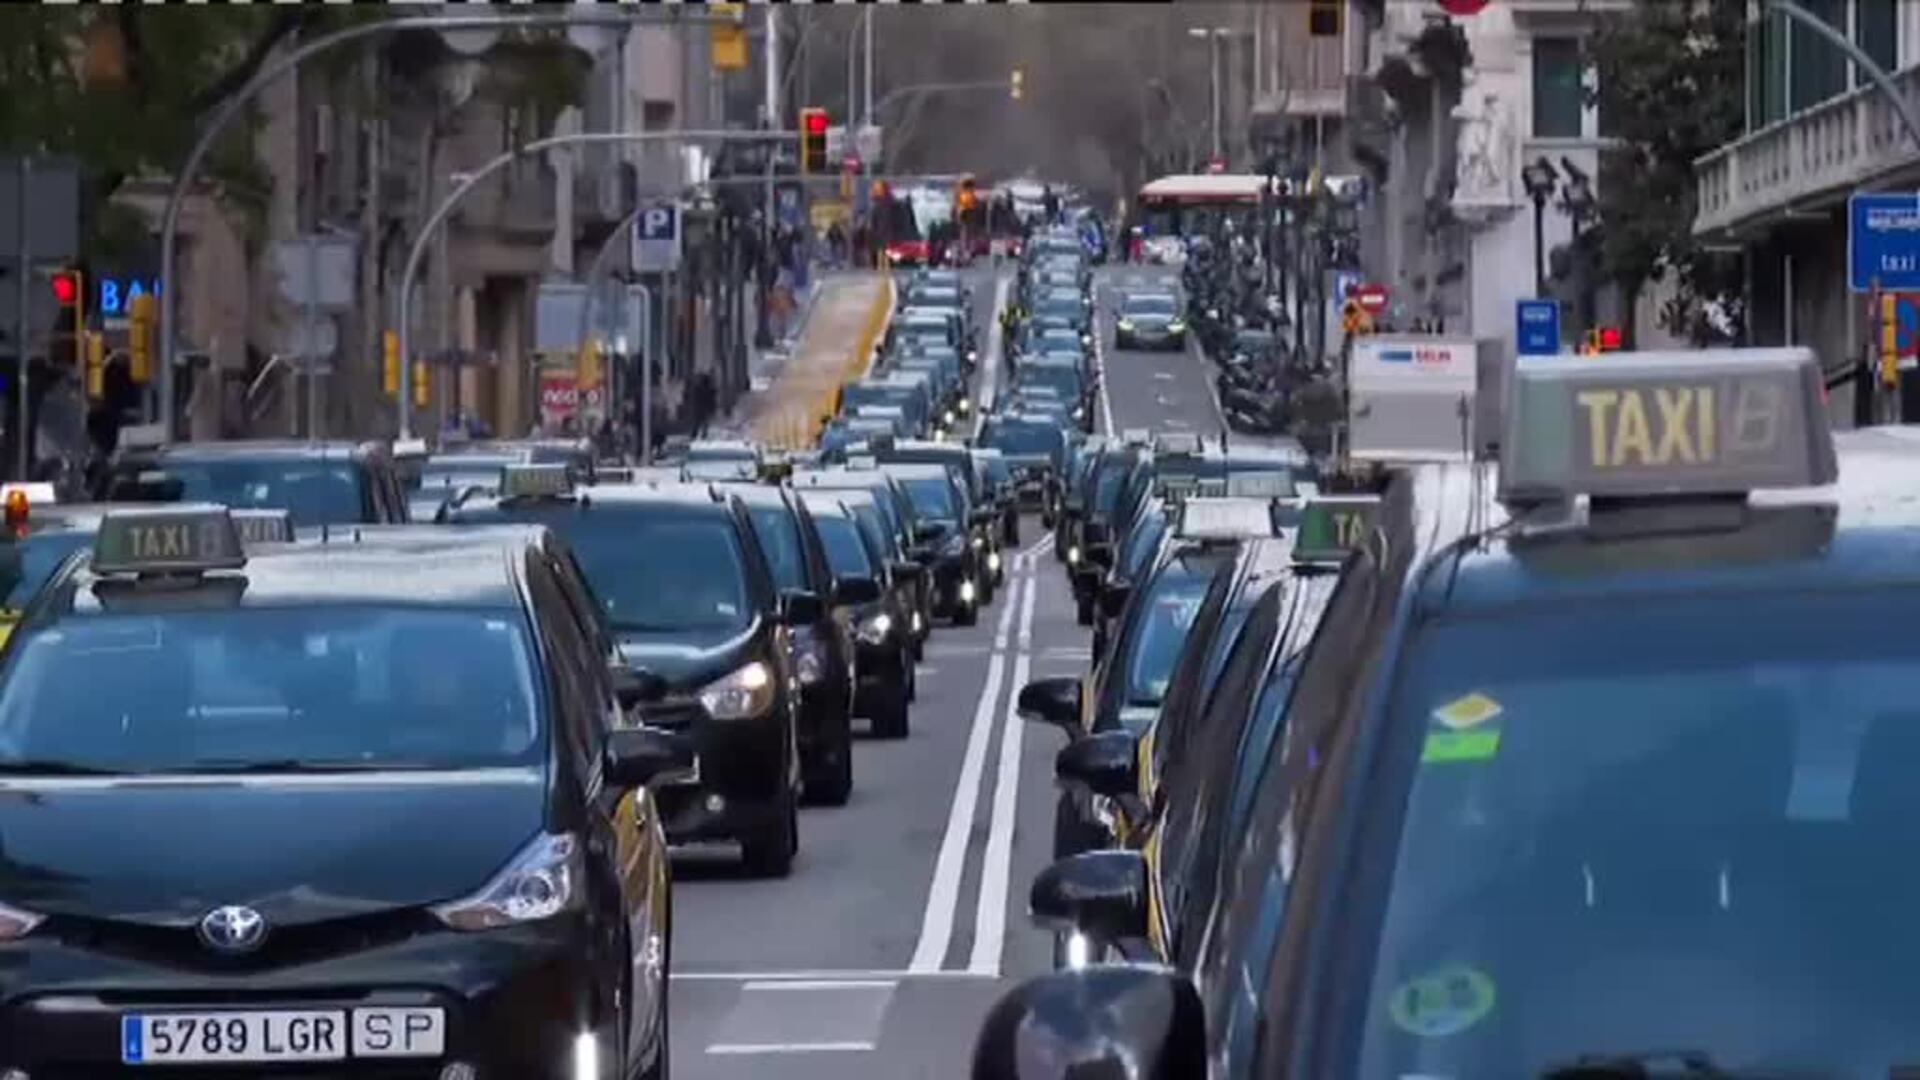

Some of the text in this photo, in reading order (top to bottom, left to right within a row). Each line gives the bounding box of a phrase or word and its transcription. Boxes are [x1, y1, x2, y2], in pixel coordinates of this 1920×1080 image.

[644, 208, 670, 236] P
[101, 279, 160, 312] BA
[1577, 386, 1715, 467] TAXI
[131, 523, 191, 557] TAXI
[1333, 513, 1365, 548] TA
[150, 1017, 335, 1054] 5789 LGR
